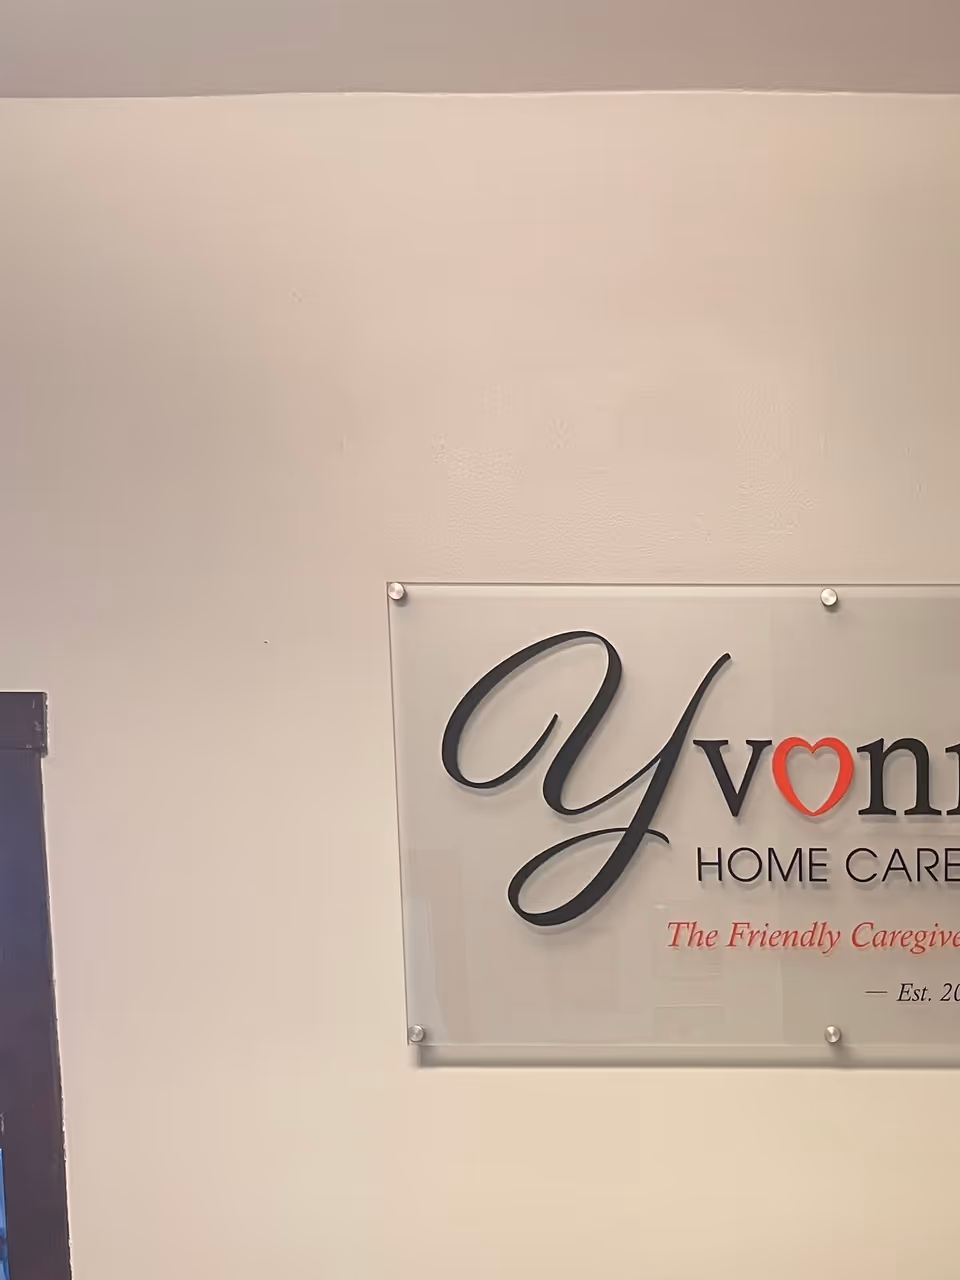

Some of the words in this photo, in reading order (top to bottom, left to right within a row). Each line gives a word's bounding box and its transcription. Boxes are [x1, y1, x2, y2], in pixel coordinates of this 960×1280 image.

[697, 846, 828, 883] HOME
[667, 920, 718, 949] The
[728, 920, 841, 955] Friendly
[896, 982, 932, 1002] Est.
